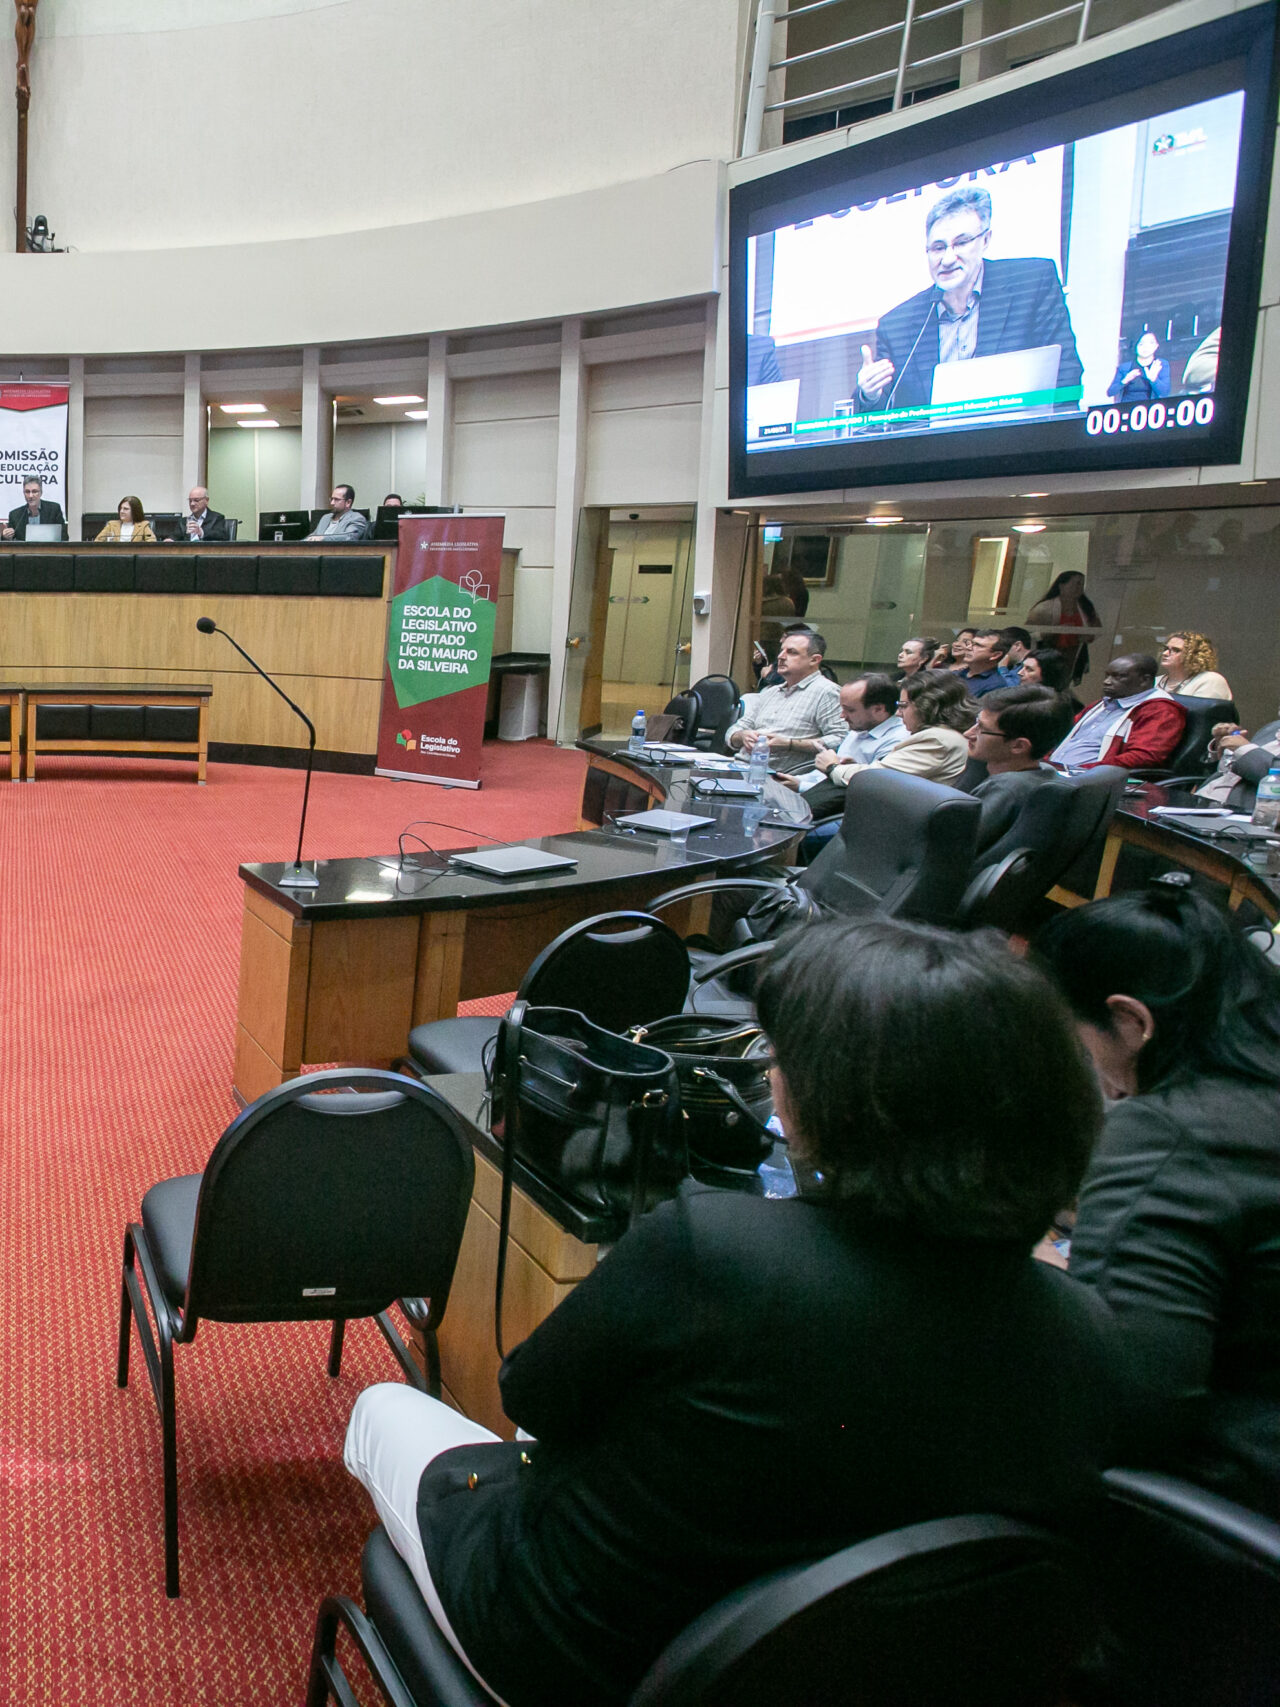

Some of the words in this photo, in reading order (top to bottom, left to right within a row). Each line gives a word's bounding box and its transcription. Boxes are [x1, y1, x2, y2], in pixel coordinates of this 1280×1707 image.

[1086, 397, 1214, 435] 00:00:00
[0, 462, 59, 474] EDUCAÇÃO
[403, 605, 451, 618] ESCOLA
[453, 607, 472, 619] DO
[401, 619, 477, 633] LEGISLATIVO
[400, 632, 466, 646] DEPUTADO
[399, 643, 430, 658] LÍCIO
[432, 647, 478, 661] MAURO
[398, 659, 415, 670] DA
[417, 660, 469, 674] SILVEIRA
[421, 734, 446, 744] Escola
[447, 738, 458, 746] do
[420, 741, 461, 754] Legislativo
